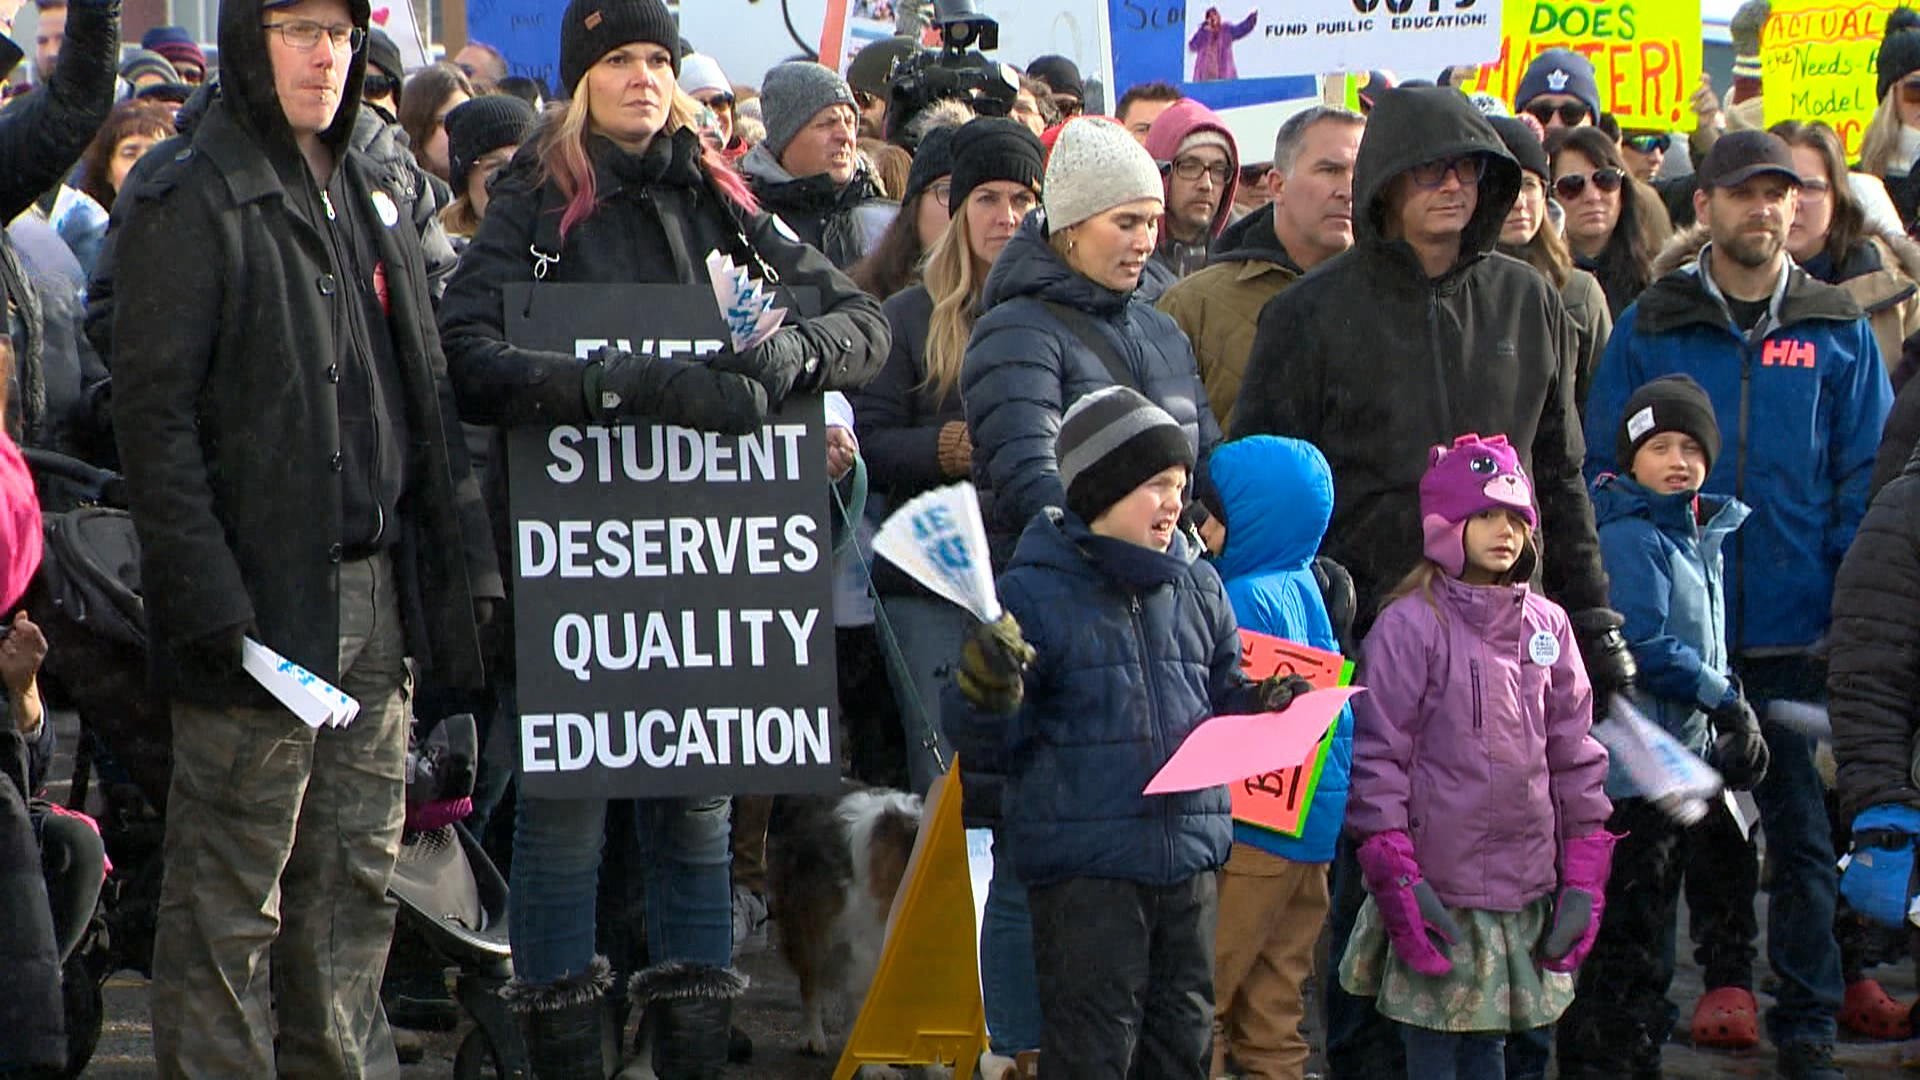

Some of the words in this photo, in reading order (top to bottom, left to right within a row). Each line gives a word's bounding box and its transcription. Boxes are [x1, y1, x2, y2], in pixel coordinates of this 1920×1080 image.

[1265, 23, 1307, 37] FUND
[1316, 19, 1374, 34] PUBLIC
[1391, 14, 1487, 30] EDUCATION!
[1530, 4, 1635, 40] DOES
[1762, 338, 1816, 369] HH
[545, 423, 807, 484] STUDENT
[517, 514, 819, 578] DESERVES
[553, 608, 820, 681] QUALITY
[520, 707, 831, 773] EDUCATION
